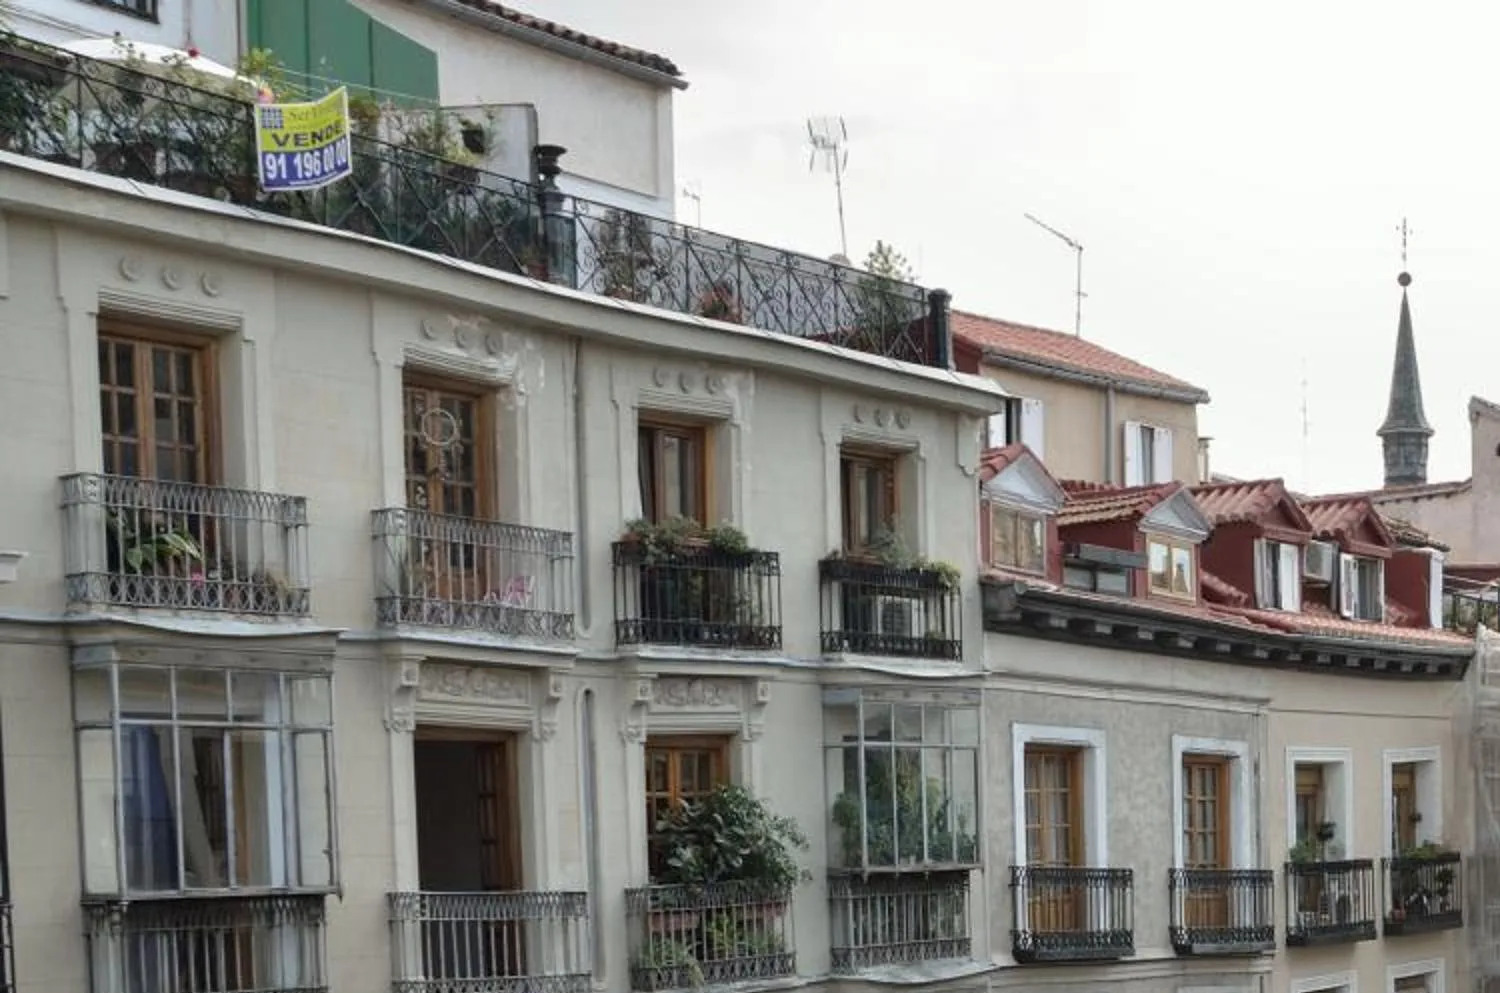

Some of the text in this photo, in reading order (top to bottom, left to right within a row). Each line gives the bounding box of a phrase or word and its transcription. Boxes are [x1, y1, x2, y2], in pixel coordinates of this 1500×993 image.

[272, 120, 343, 148] VENDE
[265, 154, 287, 179] 91
[294, 150, 321, 178] 196
